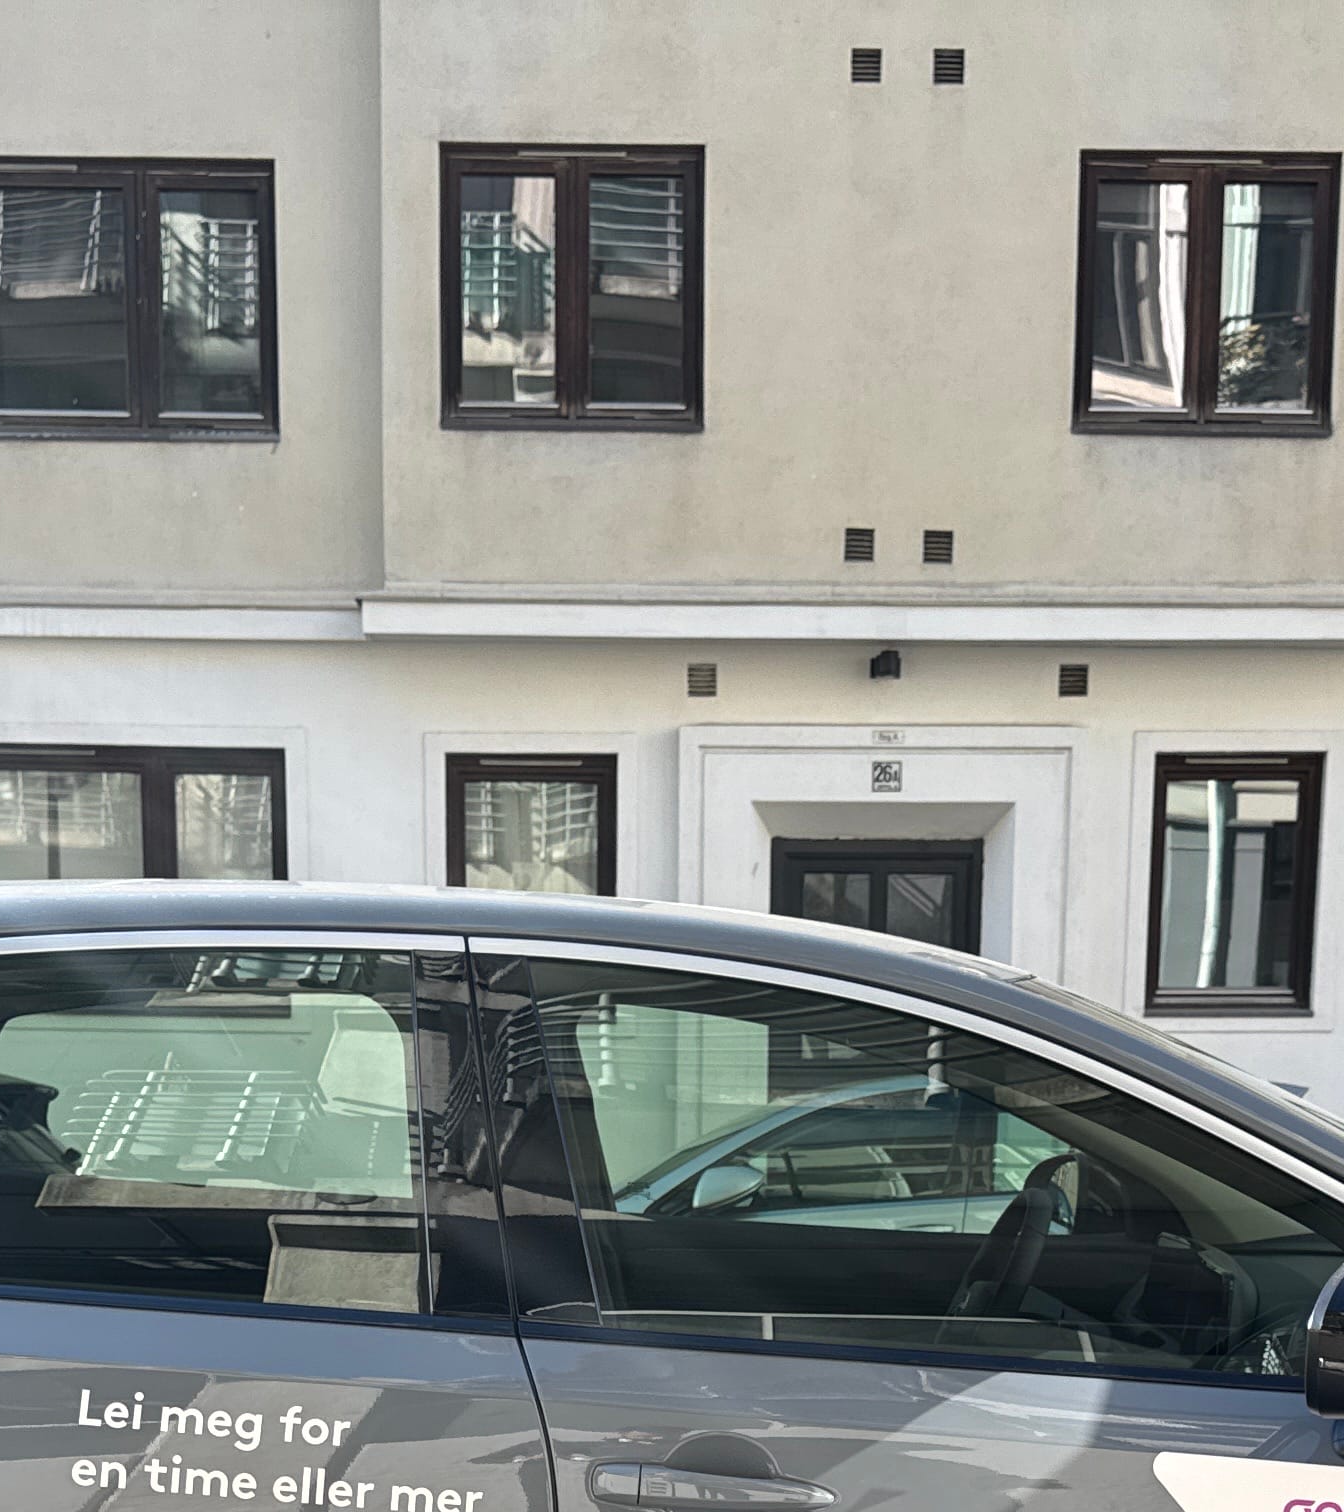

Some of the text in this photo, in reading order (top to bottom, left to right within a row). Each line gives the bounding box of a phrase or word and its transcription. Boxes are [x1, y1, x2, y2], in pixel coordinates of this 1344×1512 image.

[78, 1389, 352, 1452] Lei meg for
[71, 1459, 127, 1490] en
[144, 1454, 257, 1500] time
[272, 1466, 375, 1509] eller
